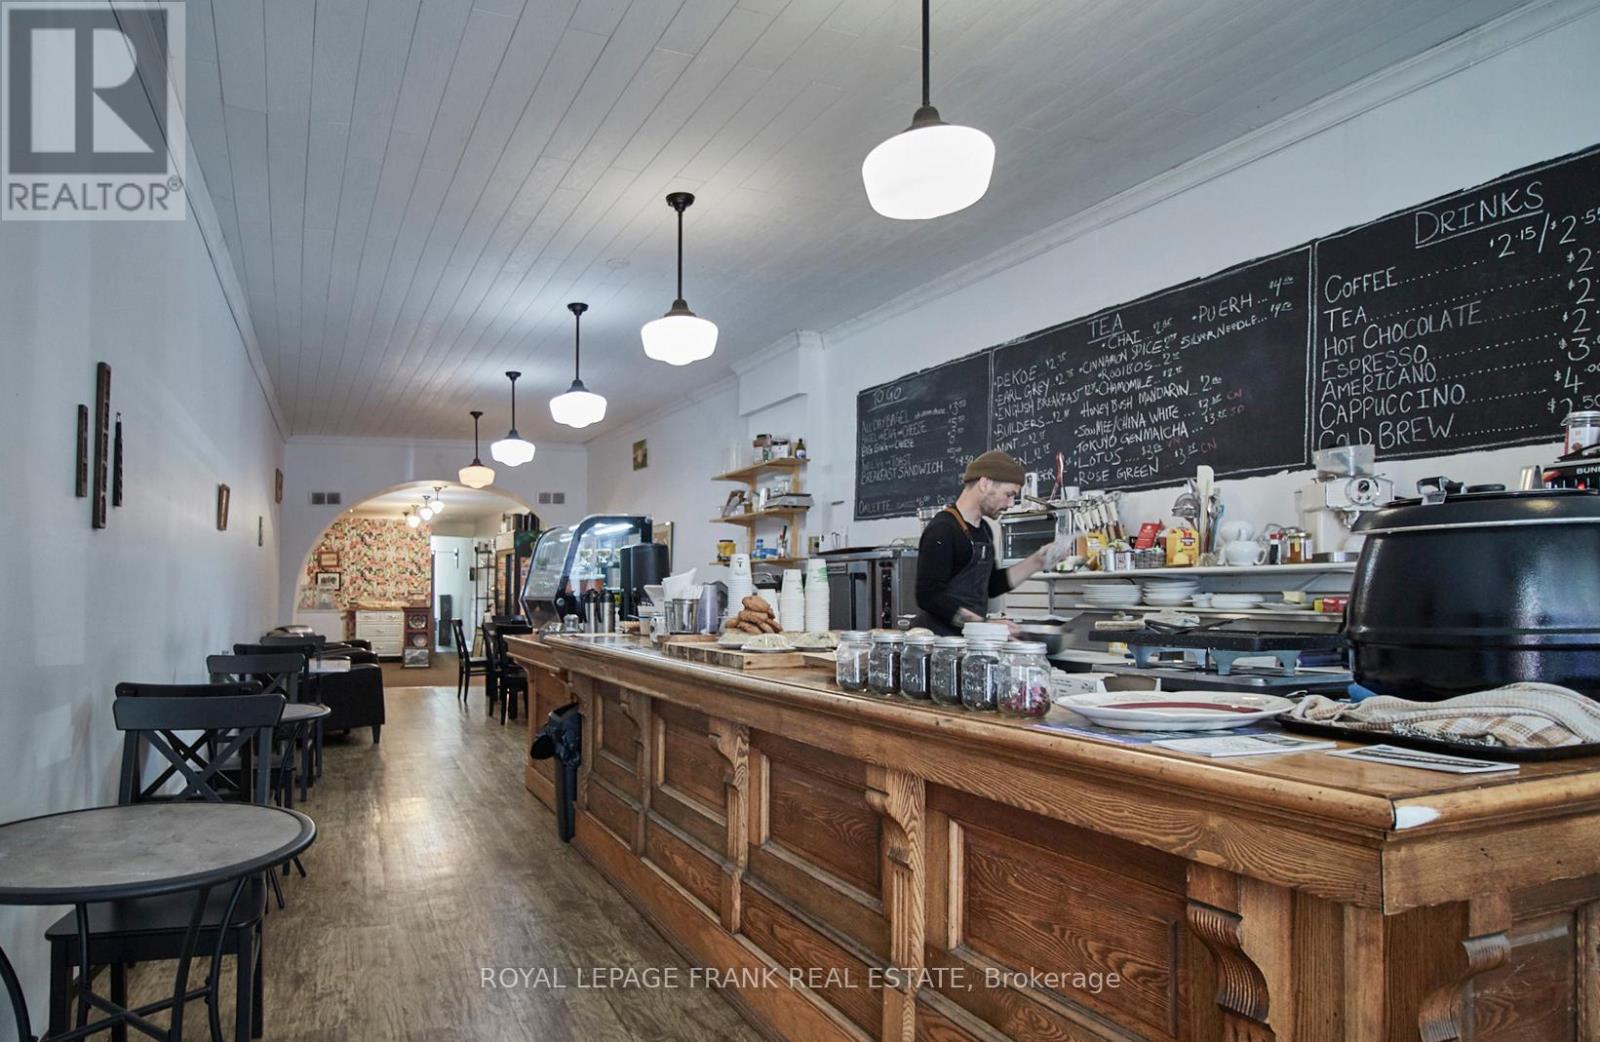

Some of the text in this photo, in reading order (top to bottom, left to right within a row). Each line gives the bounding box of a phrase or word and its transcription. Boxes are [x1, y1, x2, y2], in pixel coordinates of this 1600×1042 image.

[1415, 181, 1543, 245] DRINKS
[1324, 267, 1399, 303] COFFEE
[1198, 292, 1253, 323] PUERH
[1323, 305, 1367, 333] TEA
[1087, 312, 1124, 338] TEA
[1324, 336, 1357, 359] HOT
[1363, 300, 1482, 349] CHOCOLATE
[1107, 330, 1143, 349] CHAI
[1082, 348, 1128, 374] CINNAMON
[1131, 339, 1164, 360] SPICE
[1100, 360, 1153, 381] ROOIBOS
[1321, 344, 1428, 382] ESPRESSO
[995, 364, 1038, 392] PEKOE
[995, 389, 1022, 406] EARL
[1023, 377, 1050, 400] GREY
[1098, 375, 1156, 396] CHAMOMILE
[1320, 361, 1437, 403] AMERICANO
[995, 400, 1035, 421] ENGLISH
[1080, 401, 1109, 418] HONEY
[1138, 379, 1190, 406] MANDARIN
[1319, 384, 1466, 430] CAPPUCCINO
[1148, 404, 1180, 424] WHITE
[994, 416, 1046, 441] BUILDERS
[1119, 421, 1190, 446] GENMAICHA
[1378, 412, 1455, 450] BREW
[898, 460, 944, 480] SANDWICH
[1078, 446, 1124, 469] LOTUS
[1079, 469, 1110, 485] ROSE
[1116, 456, 1159, 481] GREEN
[1576, 465, 1600, 475] BUN
